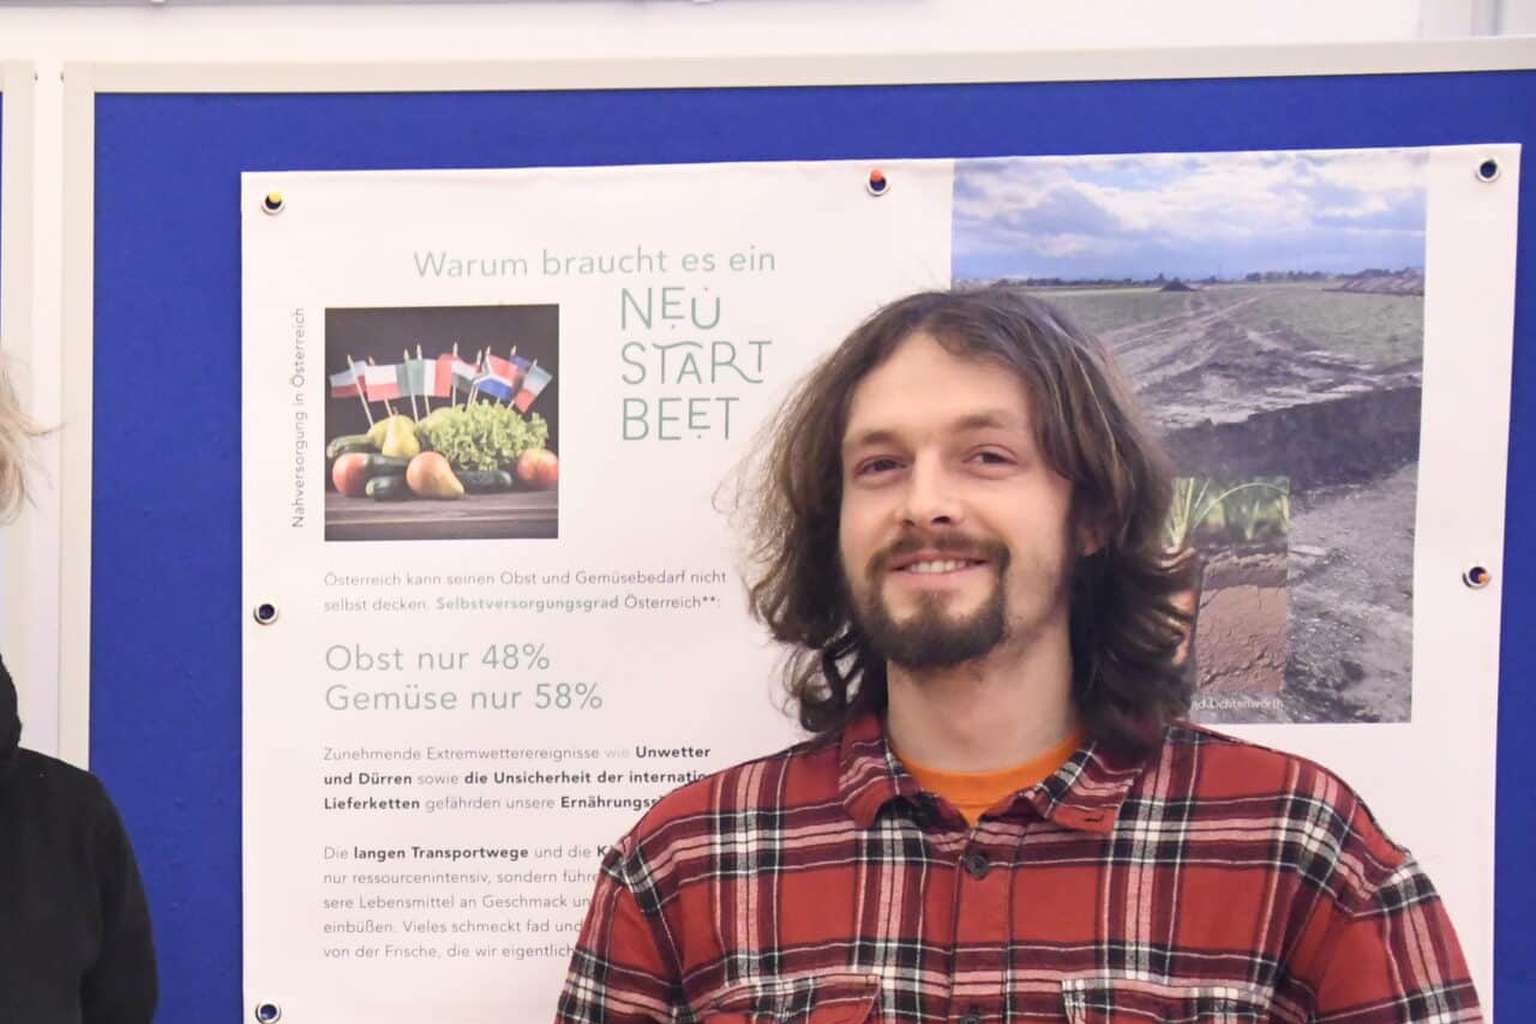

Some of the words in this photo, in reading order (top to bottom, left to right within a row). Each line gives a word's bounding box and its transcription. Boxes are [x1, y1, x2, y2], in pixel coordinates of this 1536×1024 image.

[414, 251, 527, 278] Warum
[543, 245, 667, 275] braucht
[681, 253, 715, 272] es
[729, 245, 775, 271] ein
[288, 307, 305, 388] Österreich
[621, 341, 773, 384] START
[292, 393, 305, 406] in
[622, 397, 740, 441] BEET
[291, 411, 308, 528] Nahversorgung
[324, 571, 401, 586] Österreich
[407, 571, 441, 585] kann
[447, 571, 495, 585] seinen
[500, 571, 536, 585] Obst
[542, 570, 570, 585] und
[576, 569, 685, 584] Gemüsebedarf
[691, 569, 726, 584] nicht
[324, 597, 367, 612] selbst
[436, 595, 619, 613] Selbstversorgungsgrad
[326, 643, 403, 672] Obst
[418, 652, 469, 670] nur
[482, 643, 550, 670] 48%
[326, 684, 457, 710] Gemüse
[471, 692, 522, 710] nur
[536, 682, 602, 710] 58%
[324, 747, 421, 761] Zunehmende
[427, 746, 599, 762] Extremwetterereignisse
[636, 746, 710, 758] Unwetter
[324, 772, 352, 785] und
[359, 773, 412, 785] Dürren
[418, 775, 458, 784] sowie
[465, 771, 488, 784] die
[494, 770, 590, 784] Unsicherheit
[597, 770, 624, 783] der
[325, 797, 420, 810] Lieferketten
[426, 796, 501, 813] gefährden
[506, 799, 554, 810] unsere
[324, 846, 348, 860] Die
[354, 846, 405, 862] langen
[411, 847, 528, 862] Transportwege
[535, 844, 562, 859] und
[568, 844, 590, 857] die
